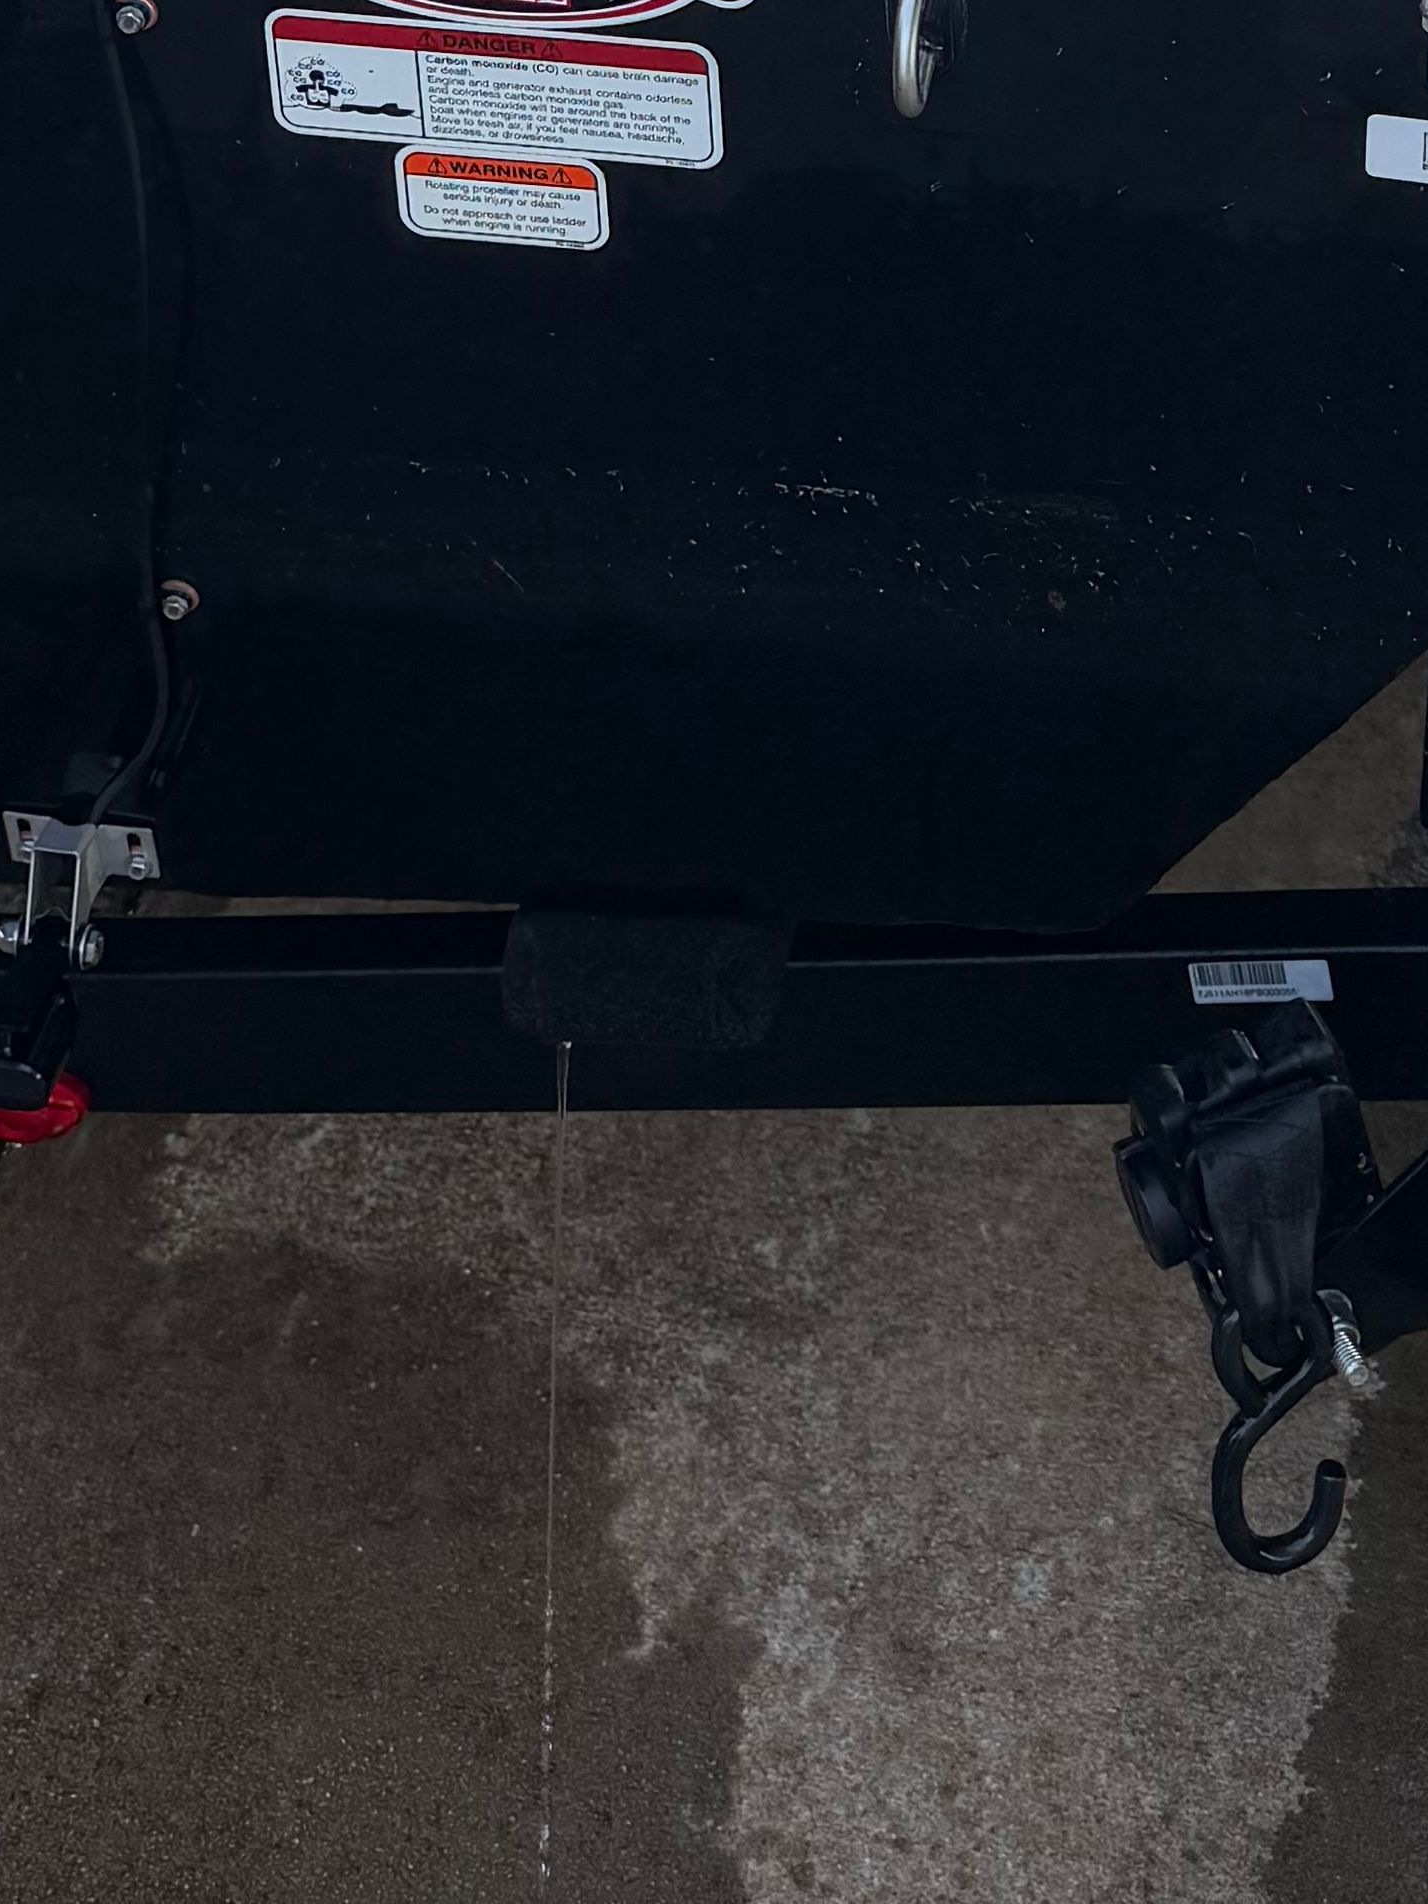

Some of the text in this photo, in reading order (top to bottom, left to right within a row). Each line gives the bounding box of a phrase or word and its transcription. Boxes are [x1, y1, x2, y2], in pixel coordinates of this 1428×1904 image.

[443, 34, 536, 55] DANGER
[425, 54, 699, 87] Carbon monoxide (CO) can cause brain damage
[426, 66, 474, 77] or death.
[427, 75, 693, 105] Engine and generator exhaust contains odorless
[428, 85, 449, 95] and
[452, 87, 501, 99] colorless
[504, 91, 542, 102] carbon
[546, 96, 600, 107] monoxide
[429, 94, 691, 125] Carbon monoxide will be around the back of the
[430, 104, 678, 135] boat when engines or generators are running.
[431, 114, 460, 126] Move
[464, 117, 474, 126] to
[477, 118, 504, 129] fresh
[526, 123, 533, 131] if
[535, 125, 556, 136] you
[559, 124, 579, 135] feel
[582, 128, 624, 140] nausea,
[627, 132, 685, 145] headache,
[432, 125, 485, 138] dizziness,
[488, 130, 499, 138] or
[449, 160, 549, 180] WARNING
[425, 179, 581, 201] Rotating propeller may cause
[442, 192, 564, 210] serious injury or death.
[424, 204, 587, 227] Do not approach or use ladder
[441, 217, 569, 236] when engine is running.
